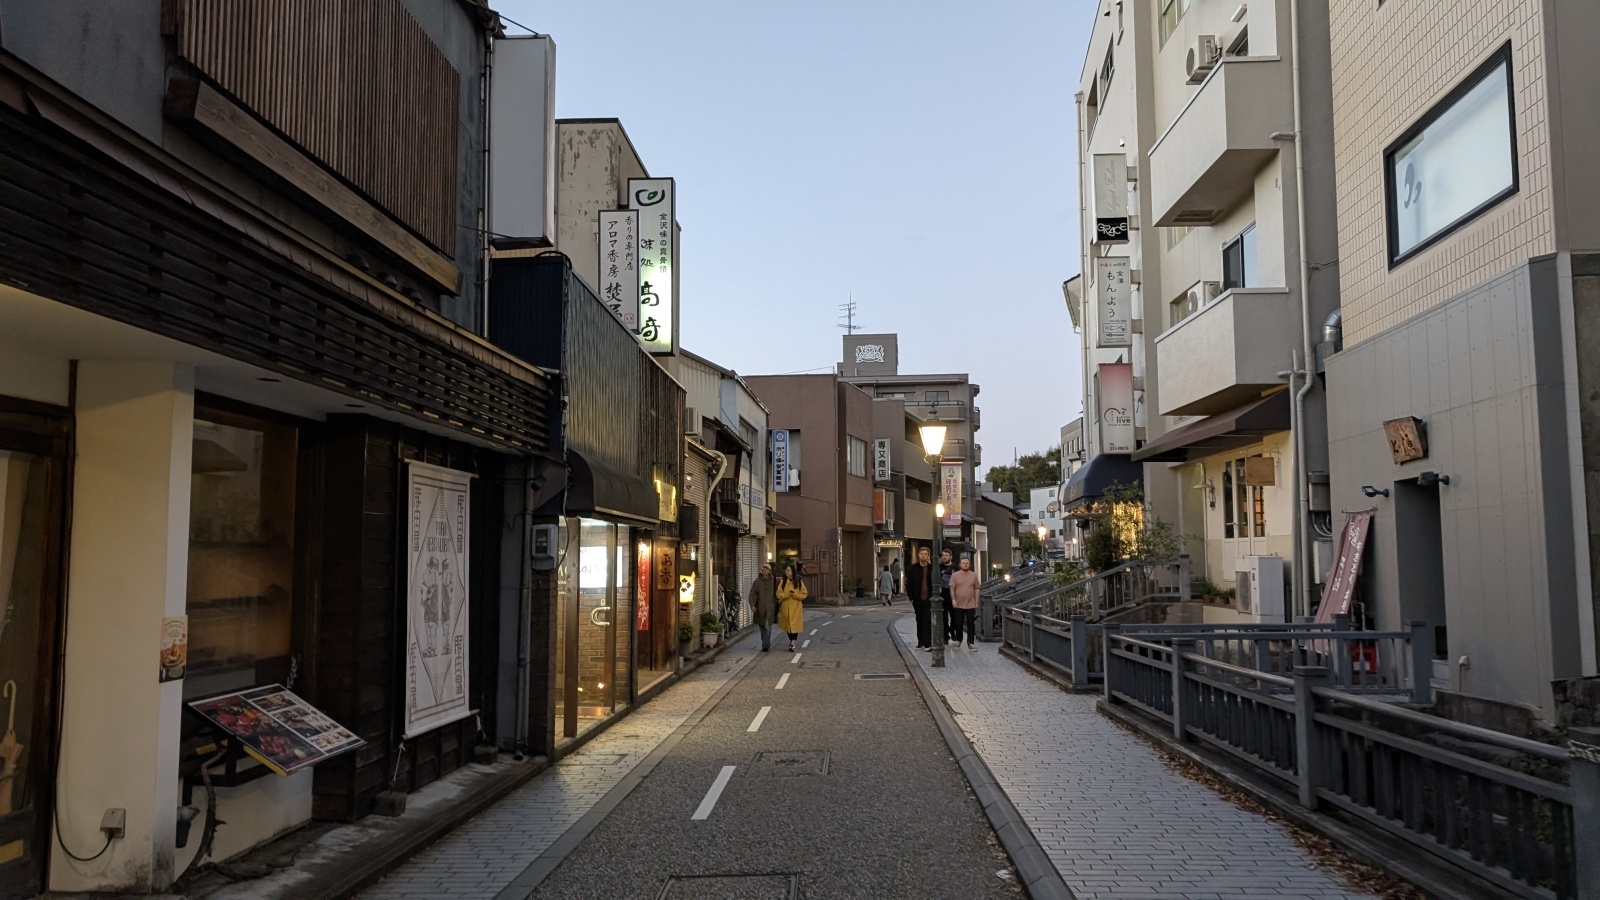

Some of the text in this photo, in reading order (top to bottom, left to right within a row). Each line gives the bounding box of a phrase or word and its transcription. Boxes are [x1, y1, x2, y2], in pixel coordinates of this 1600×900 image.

[607, 220, 620, 278] アロマ香房
[624, 215, 634, 271] 香りの専門店
[1097, 222, 1127, 237] GRACE
[1105, 270, 1117, 318] もんよう
[660, 553, 673, 586] お香
